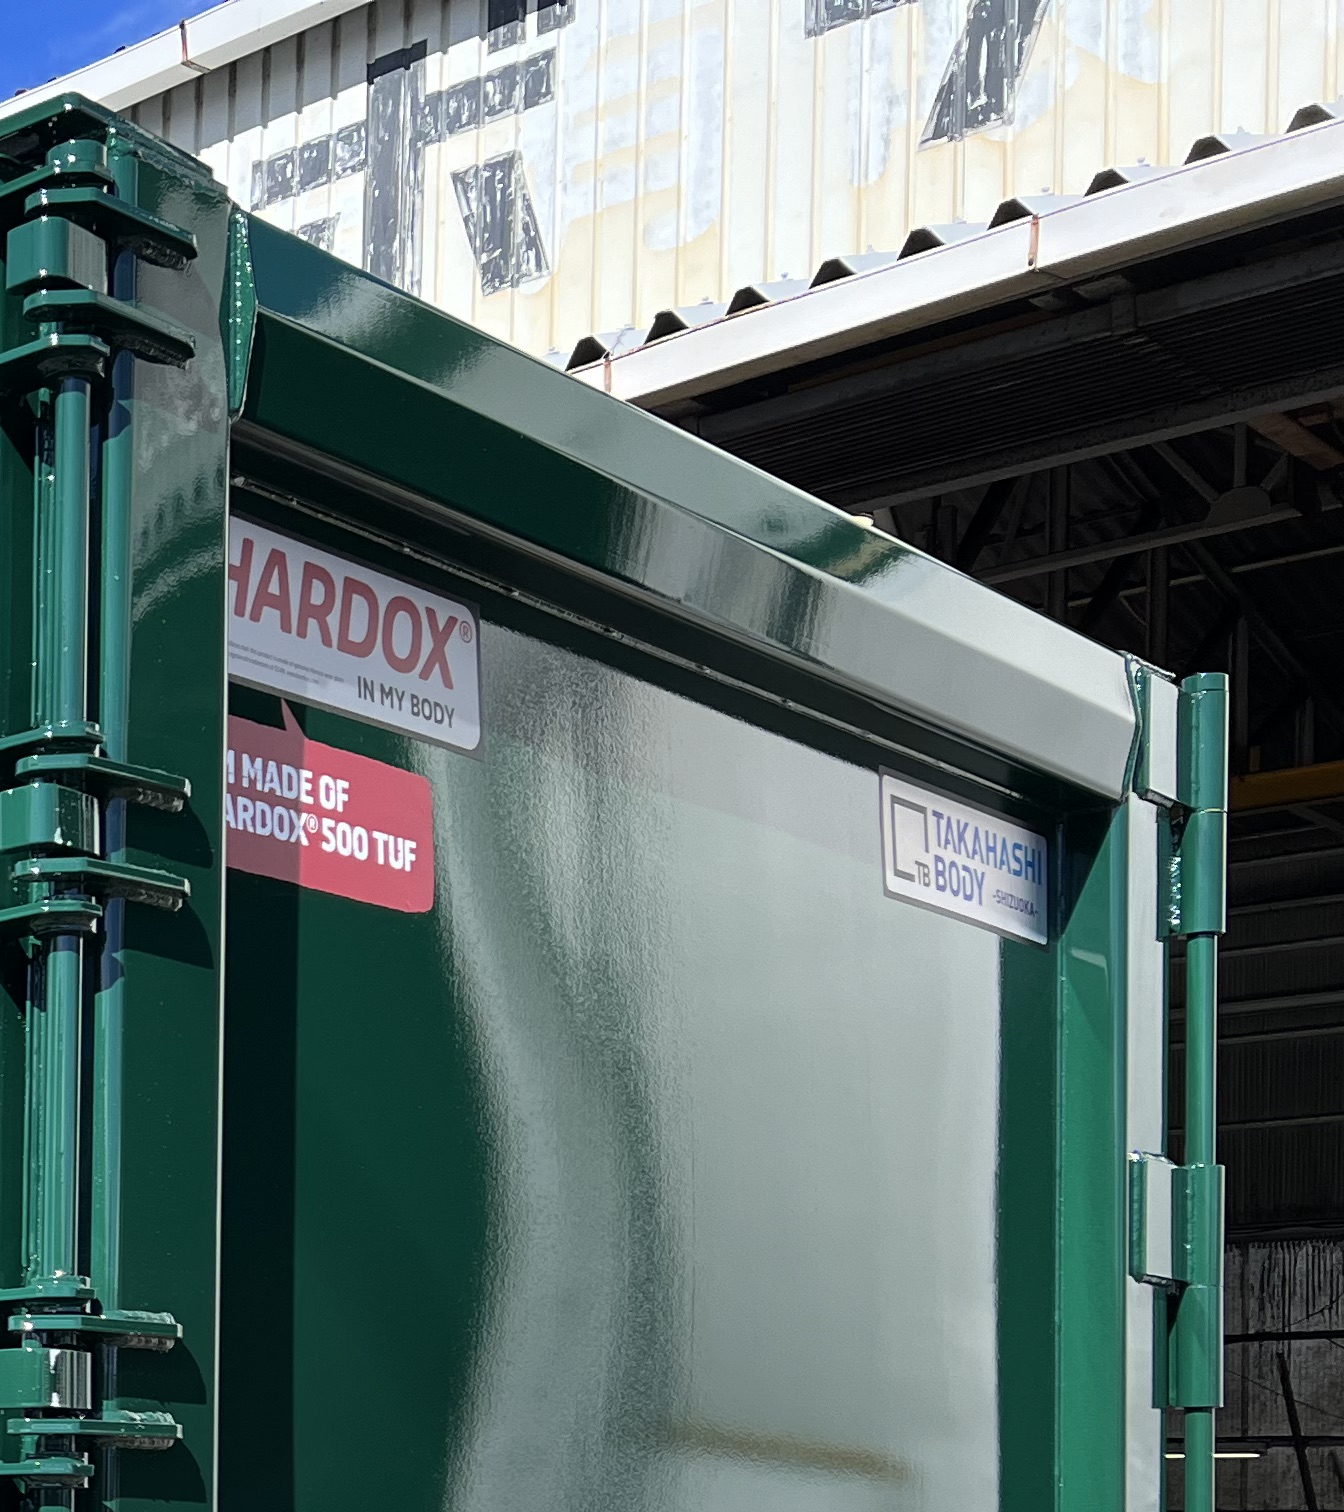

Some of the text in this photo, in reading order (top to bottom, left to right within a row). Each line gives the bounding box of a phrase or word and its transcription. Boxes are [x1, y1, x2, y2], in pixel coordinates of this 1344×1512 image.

[357, 675, 455, 729] IN MY BODY
[242, 753, 314, 804] MADE
[319, 775, 350, 812] OF
[321, 817, 368, 861] 500
[372, 830, 417, 872] TUF
[931, 809, 1042, 885] TAKAHASHI
[914, 860, 930, 887] TB
[933, 854, 985, 906] BODY
